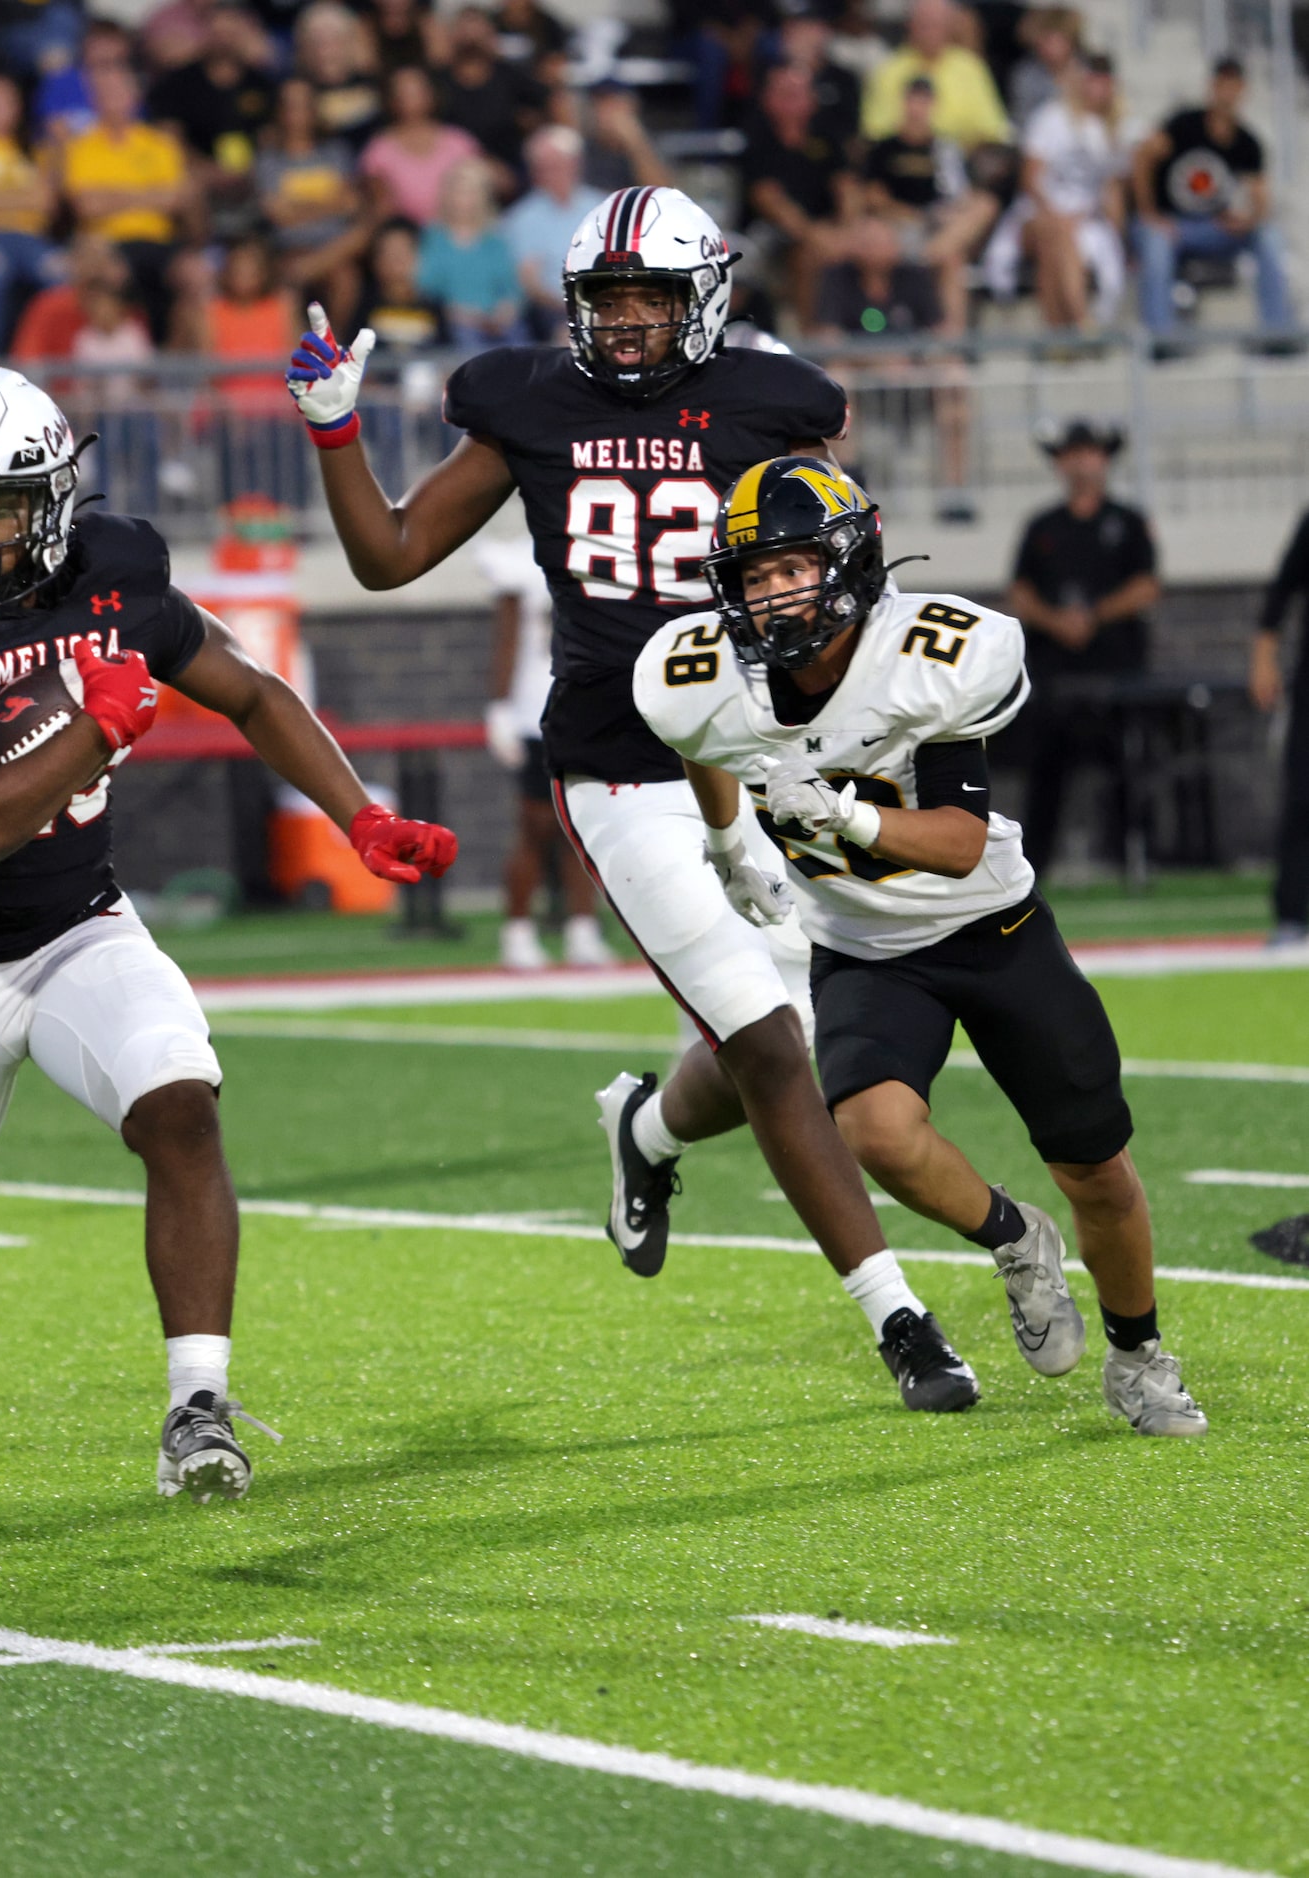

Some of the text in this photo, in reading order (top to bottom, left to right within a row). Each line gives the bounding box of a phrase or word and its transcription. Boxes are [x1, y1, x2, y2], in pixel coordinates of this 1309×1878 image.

[571, 436, 705, 471] MELISSA
[780, 466, 873, 523] M
[564, 475, 724, 606] 82
[726, 528, 758, 547] WTB
[663, 624, 728, 689] 28
[899, 601, 983, 668] 28
[804, 736, 823, 754] M
